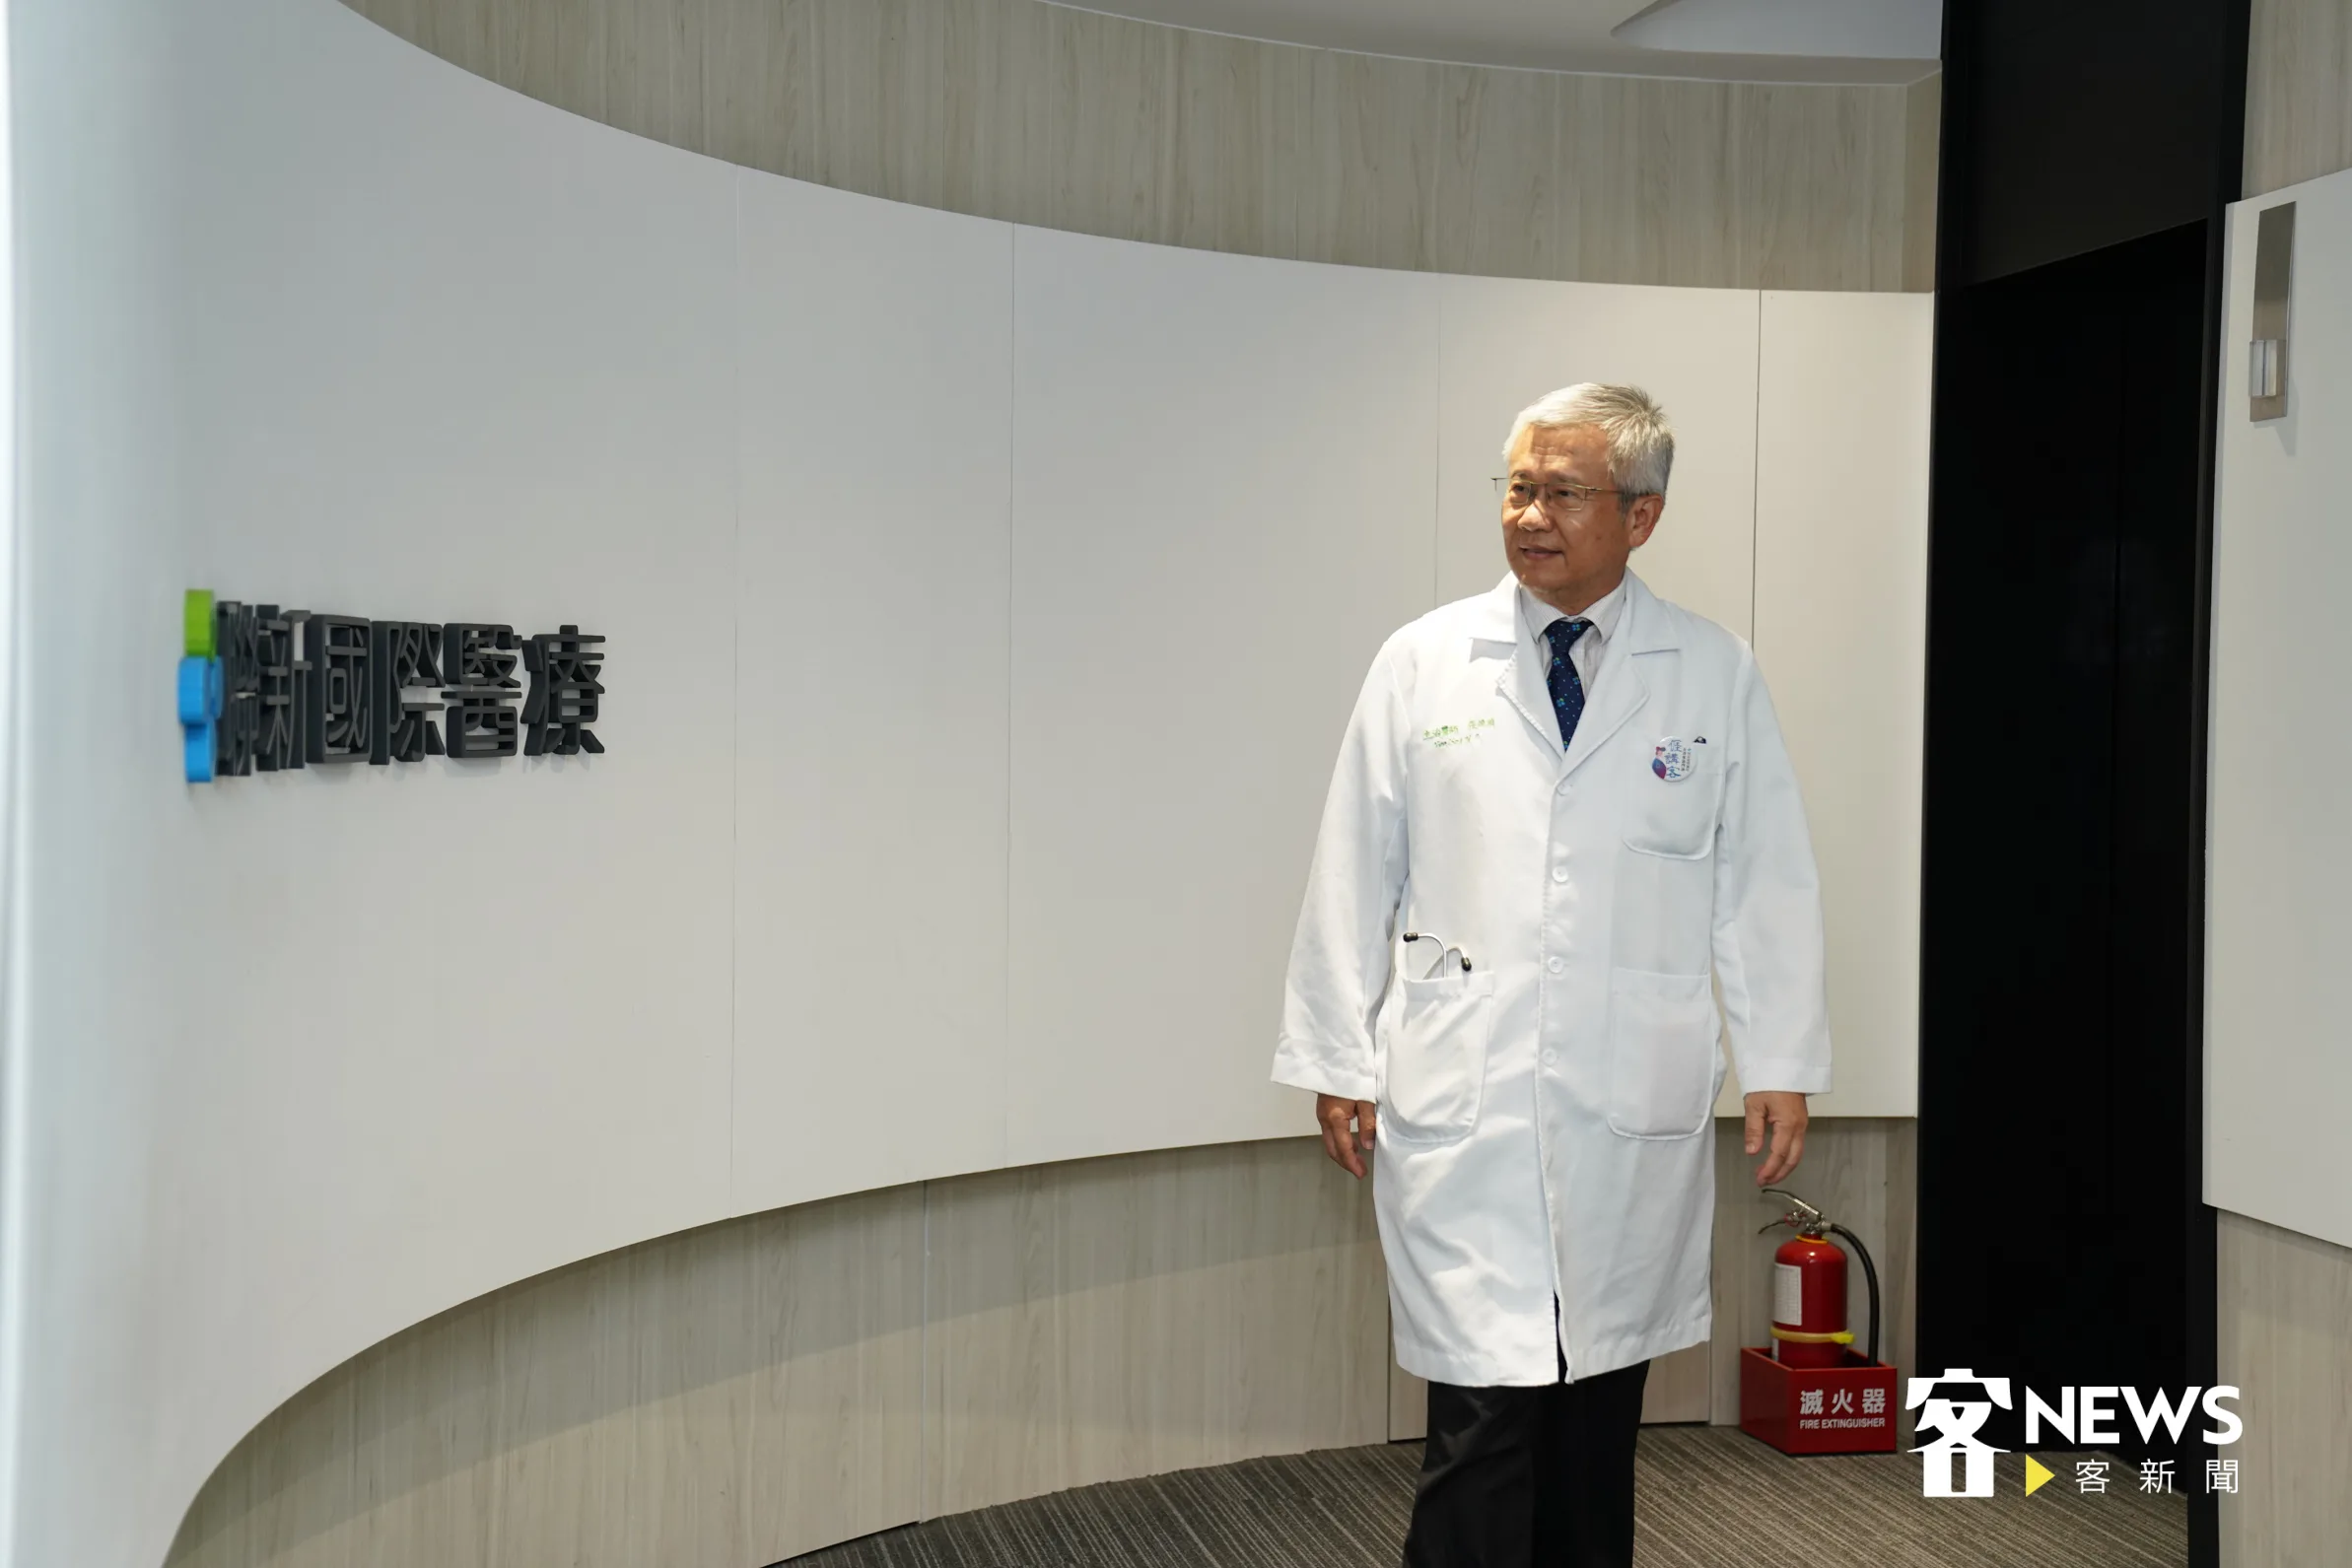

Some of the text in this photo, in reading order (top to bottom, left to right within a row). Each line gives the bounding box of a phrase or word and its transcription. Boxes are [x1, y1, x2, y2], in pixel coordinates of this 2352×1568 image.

[1800, 1388, 1886, 1415] 滅火器
[1800, 1417, 1886, 1430] FIRE EXTINGUISHER
